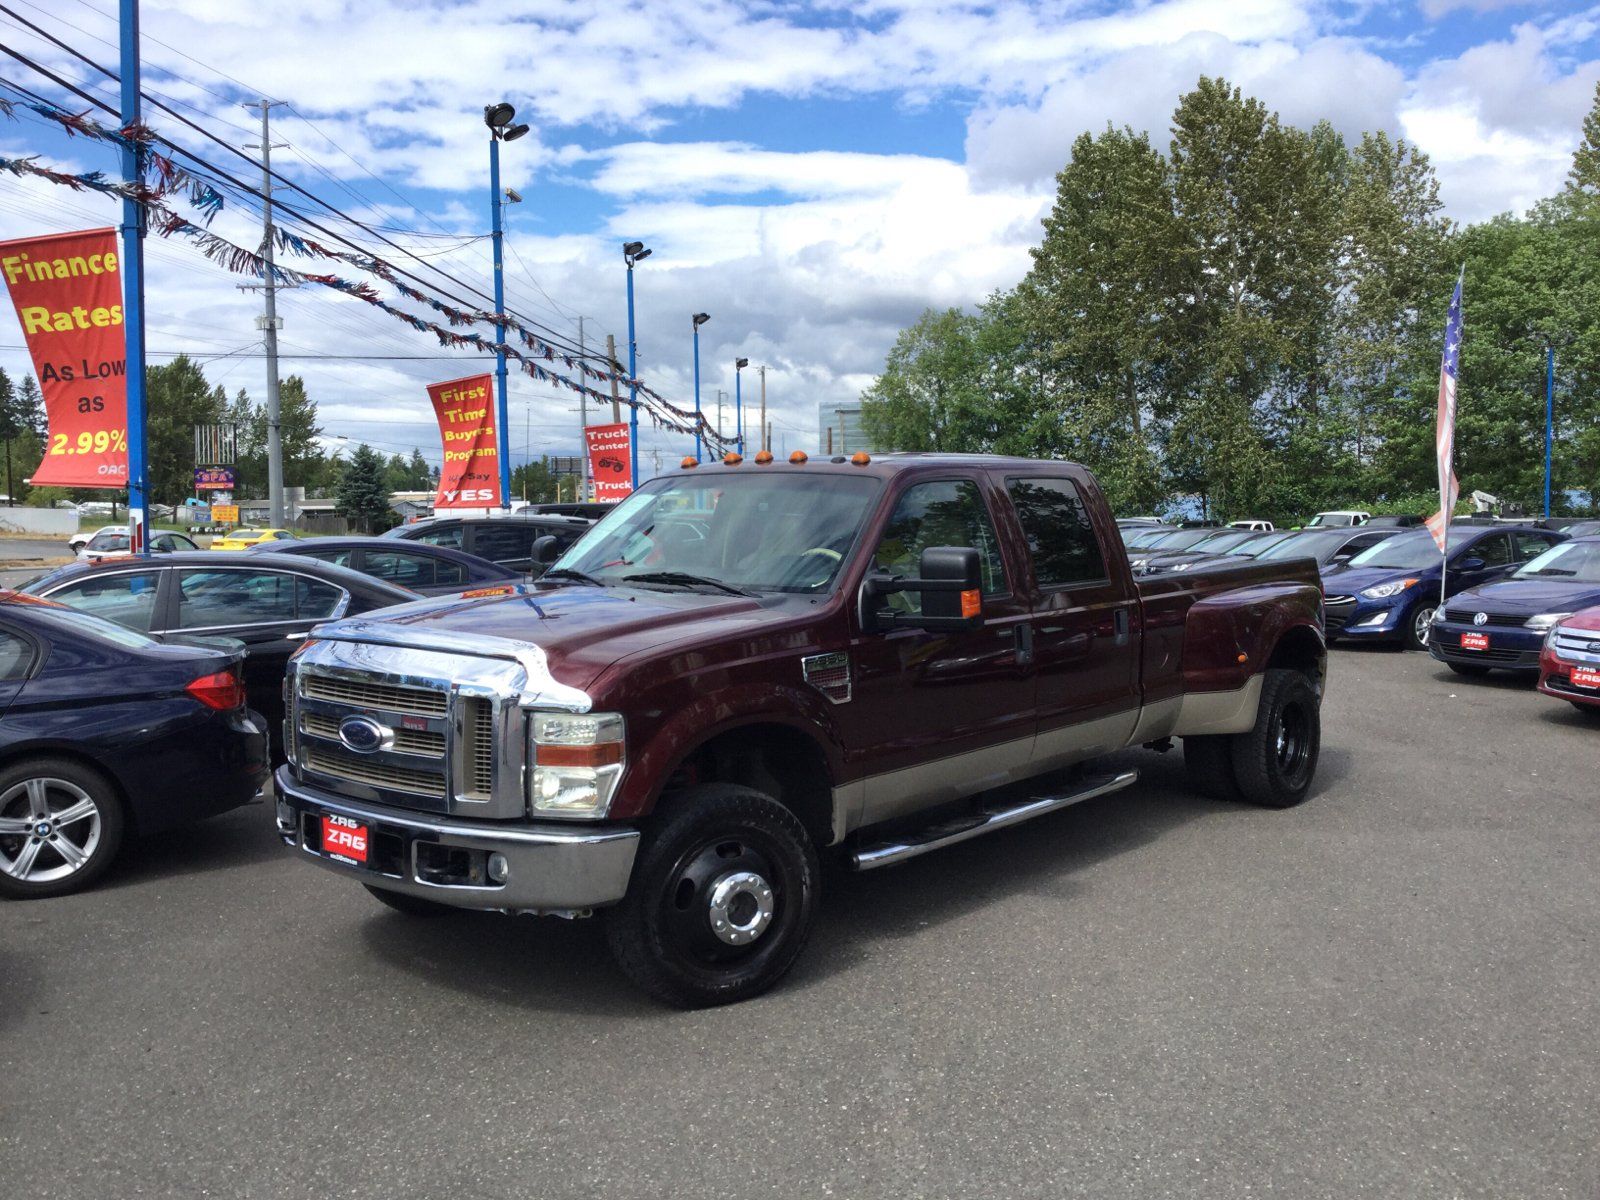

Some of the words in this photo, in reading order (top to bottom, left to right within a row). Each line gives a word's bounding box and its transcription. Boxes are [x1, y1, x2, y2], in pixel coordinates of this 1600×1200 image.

[2, 252, 119, 285] Finance
[21, 304, 124, 335] Rates
[41, 361, 75, 383] As
[82, 359, 127, 380] Low
[441, 387, 485, 403] First
[78, 395, 105, 414] as
[444, 408, 487, 424] Time
[587, 429, 628, 440] Truck
[50, 429, 127, 456] 2.99%
[590, 442, 629, 451] Center
[98, 465, 126, 475] OAC
[201, 473, 227, 482] SPA
[468, 472, 490, 482] Say
[596, 481, 632, 490] Truck
[443, 489, 493, 501] YES
[1464, 638, 1487, 646] ZAG
[1574, 673, 1600, 682] ZAG
[329, 814, 358, 829] ZAG
[327, 828, 367, 851] ZAG
